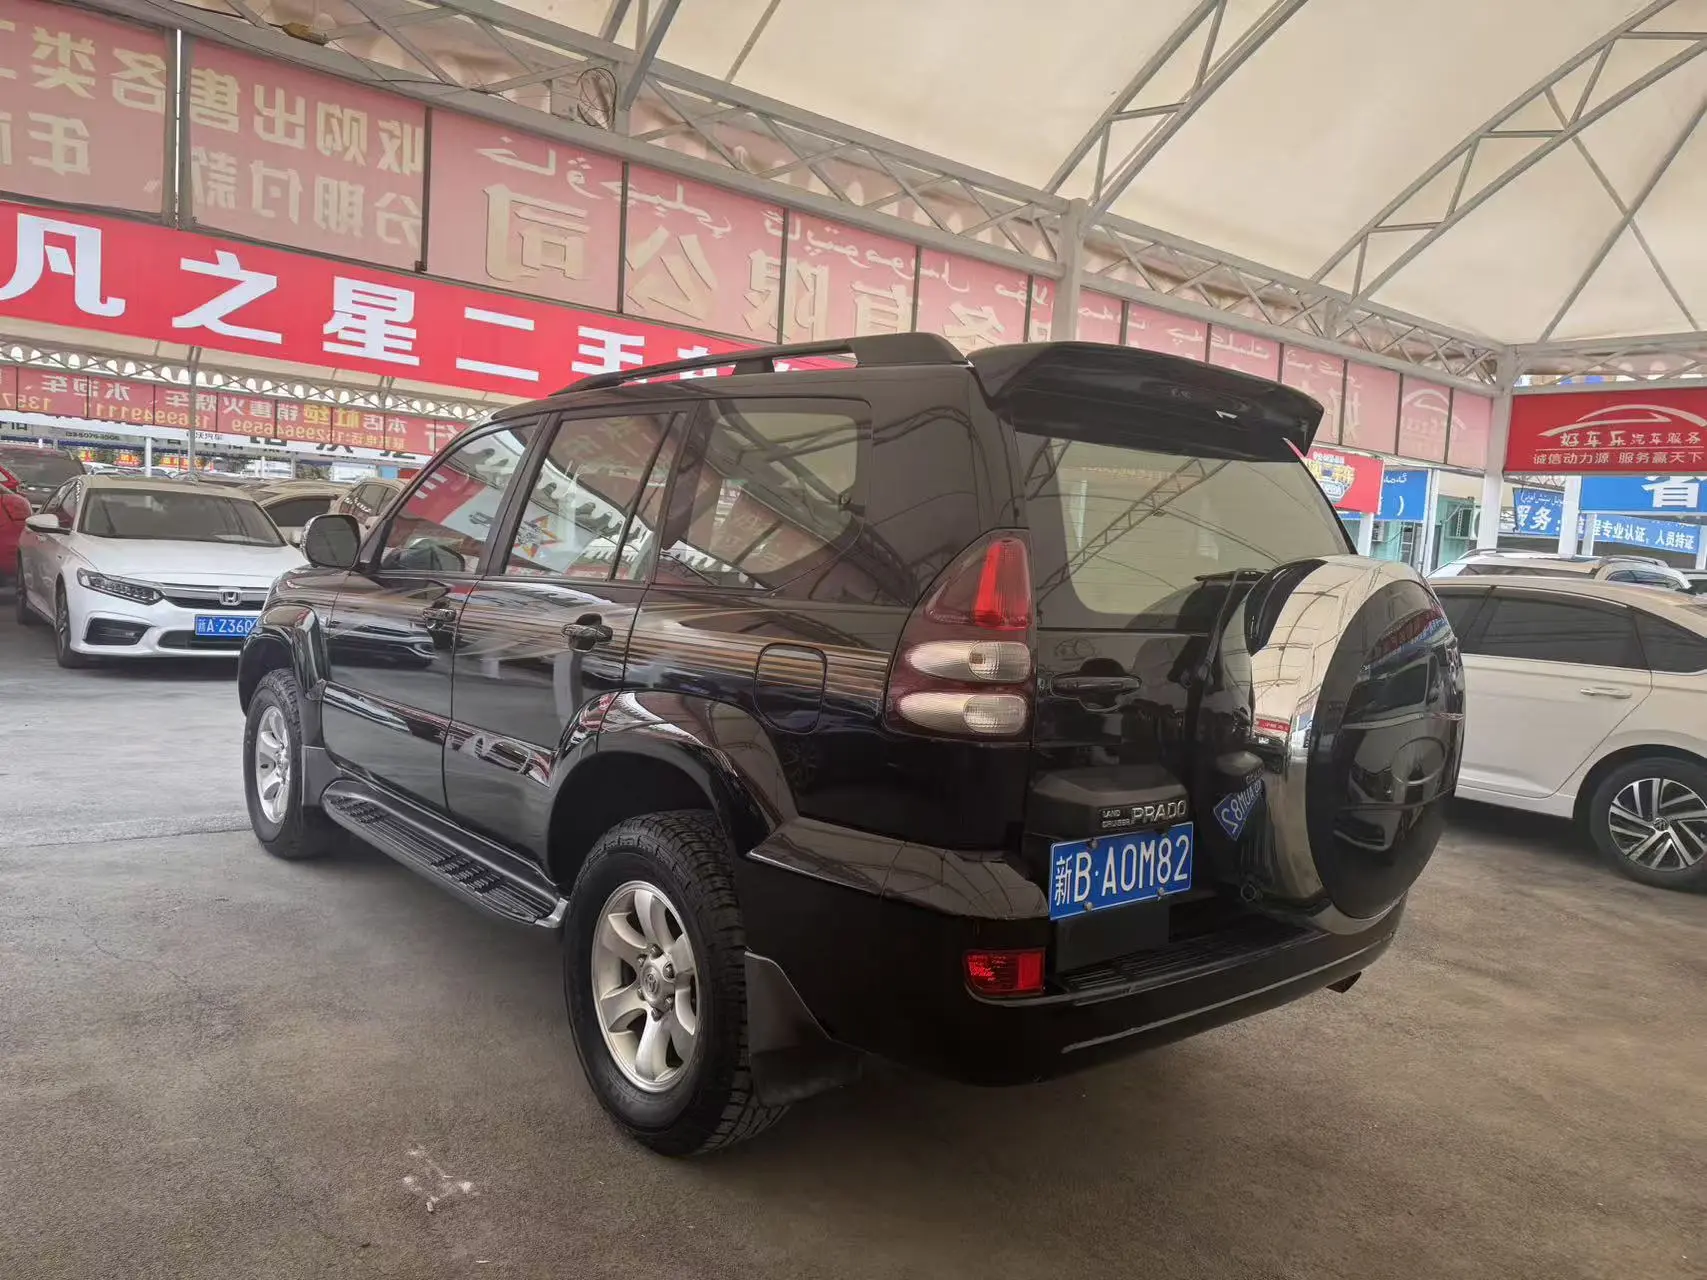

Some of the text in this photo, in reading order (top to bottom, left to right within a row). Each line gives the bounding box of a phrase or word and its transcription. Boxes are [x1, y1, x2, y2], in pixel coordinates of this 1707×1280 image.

[1533, 452, 1610, 465] 诚信动力源
[1102, 809, 1121, 818] LAND
[1132, 800, 1187, 823] PRADO
